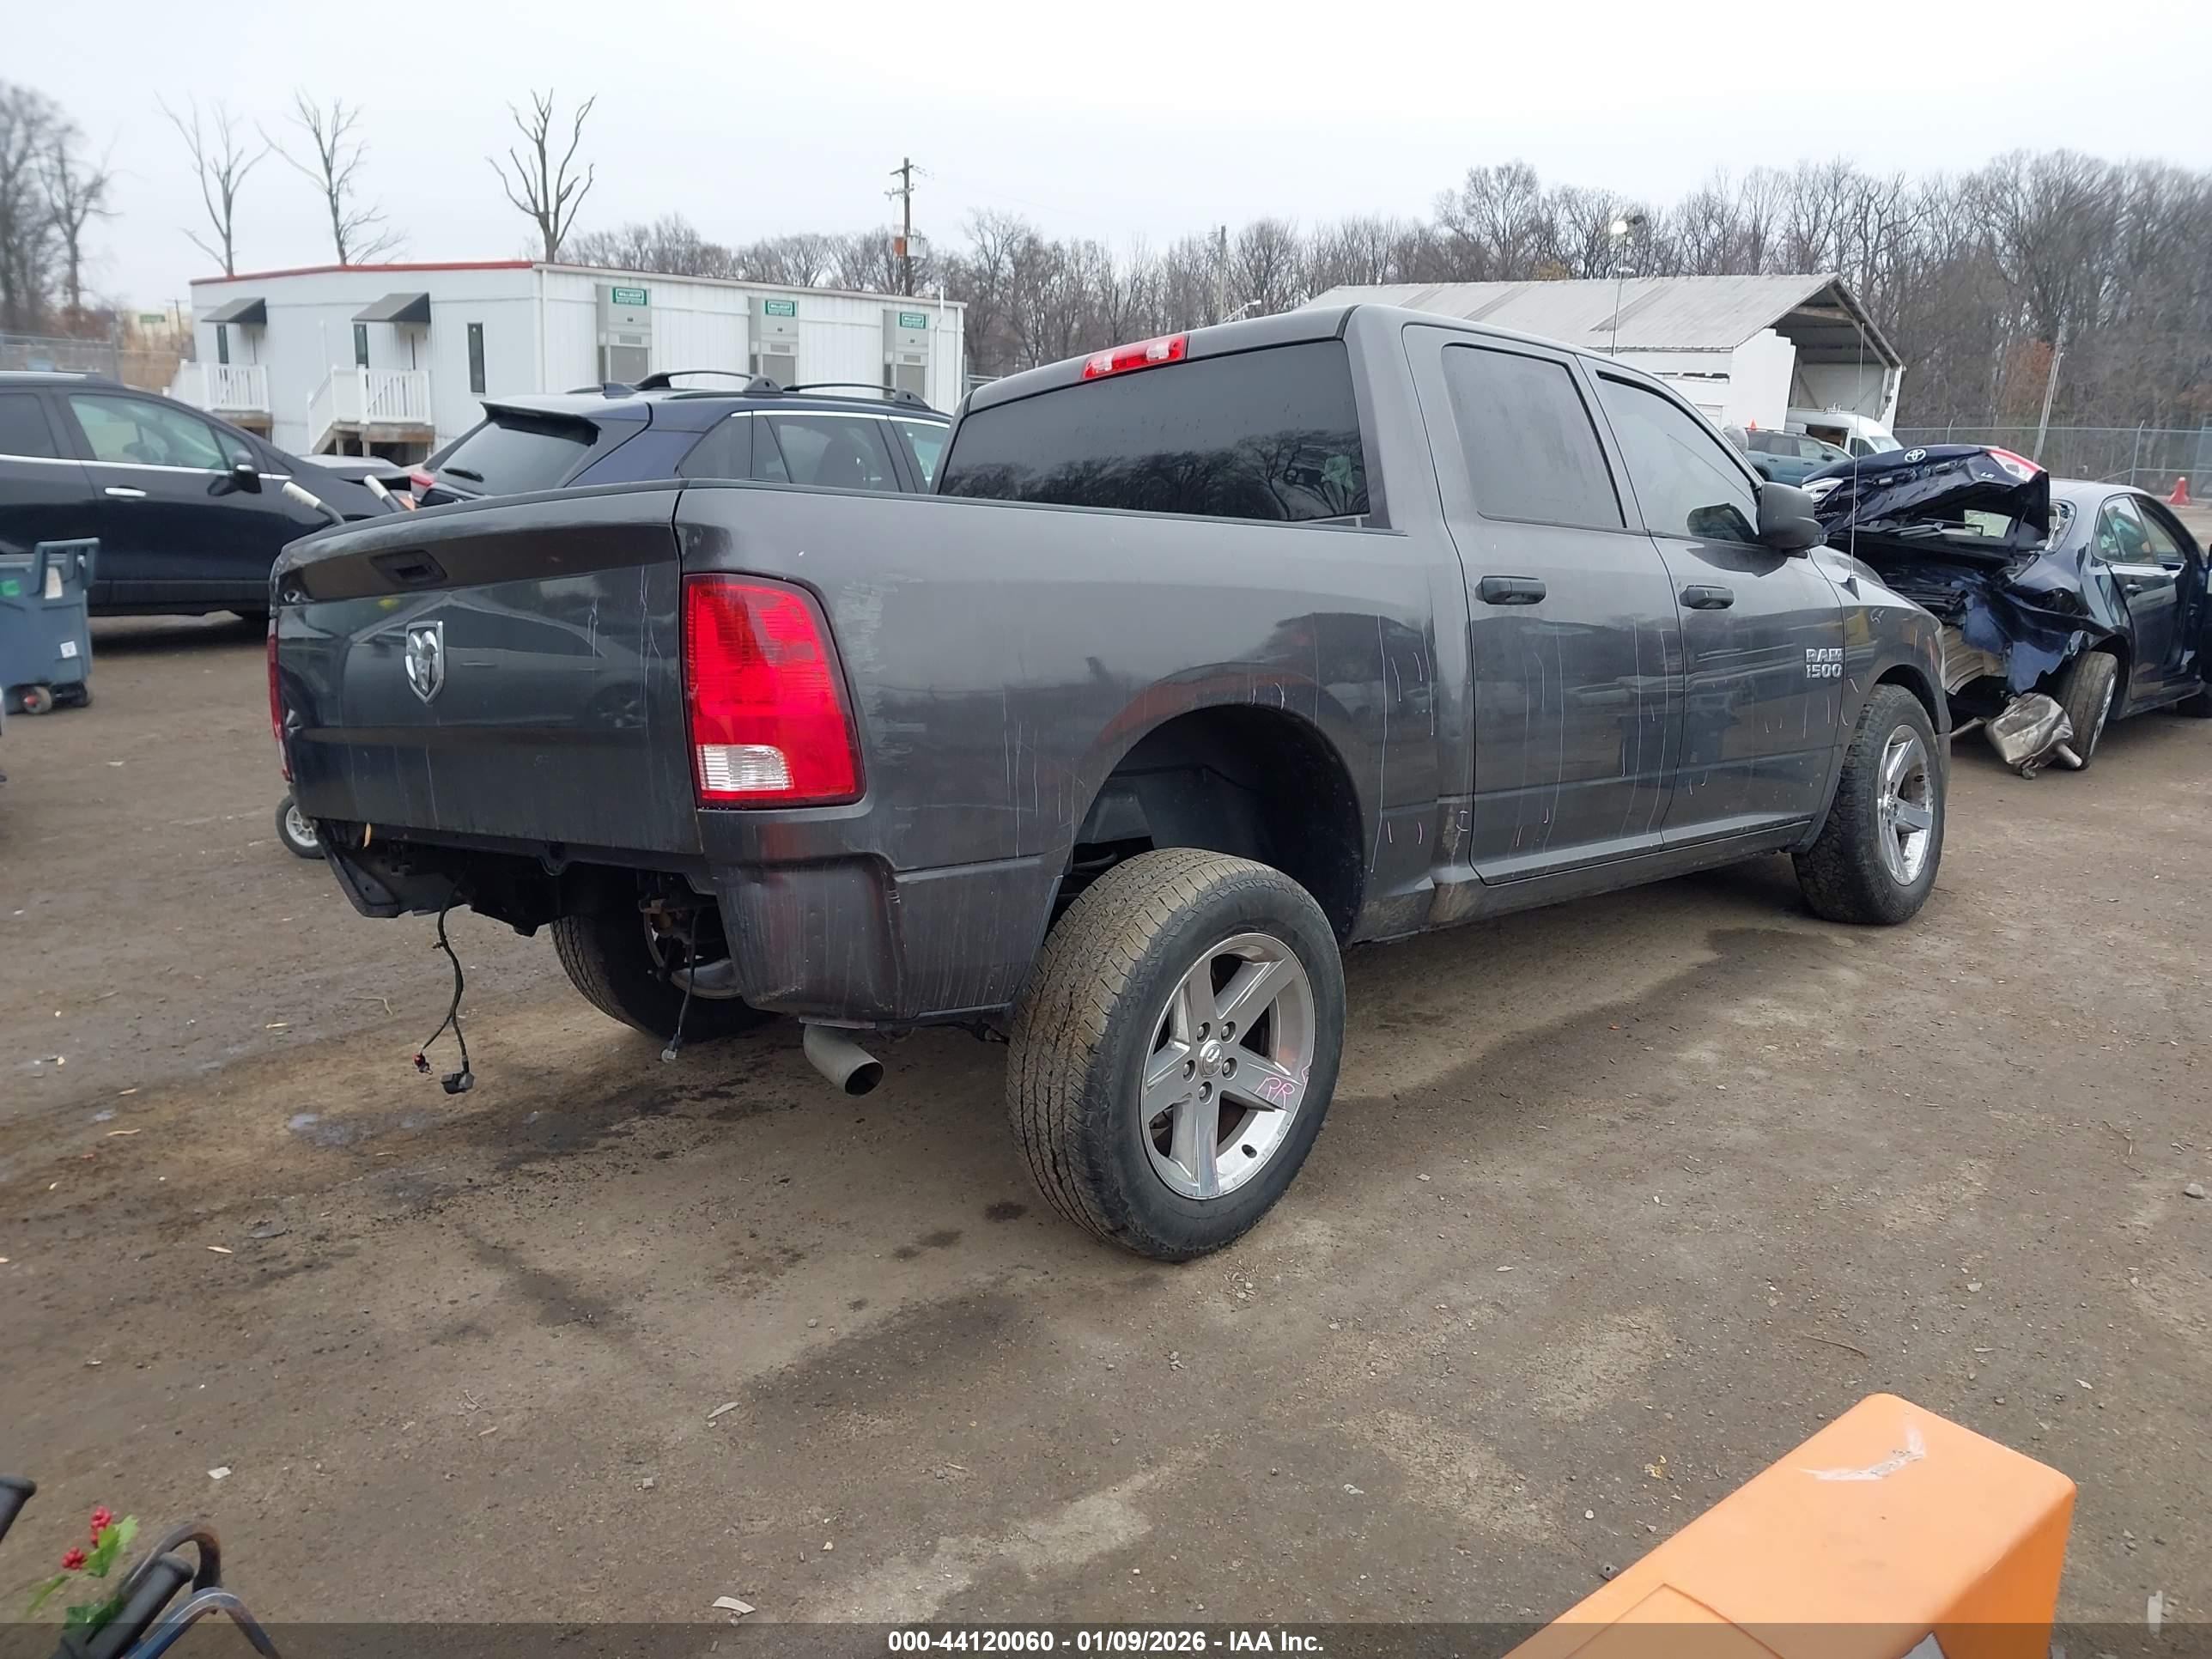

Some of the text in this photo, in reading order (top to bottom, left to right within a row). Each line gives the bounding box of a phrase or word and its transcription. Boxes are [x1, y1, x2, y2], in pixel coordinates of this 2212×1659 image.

[1806, 647, 1843, 662] RAM
[1806, 663, 1843, 678] 1500
[1255, 1077, 1296, 1109] RR
